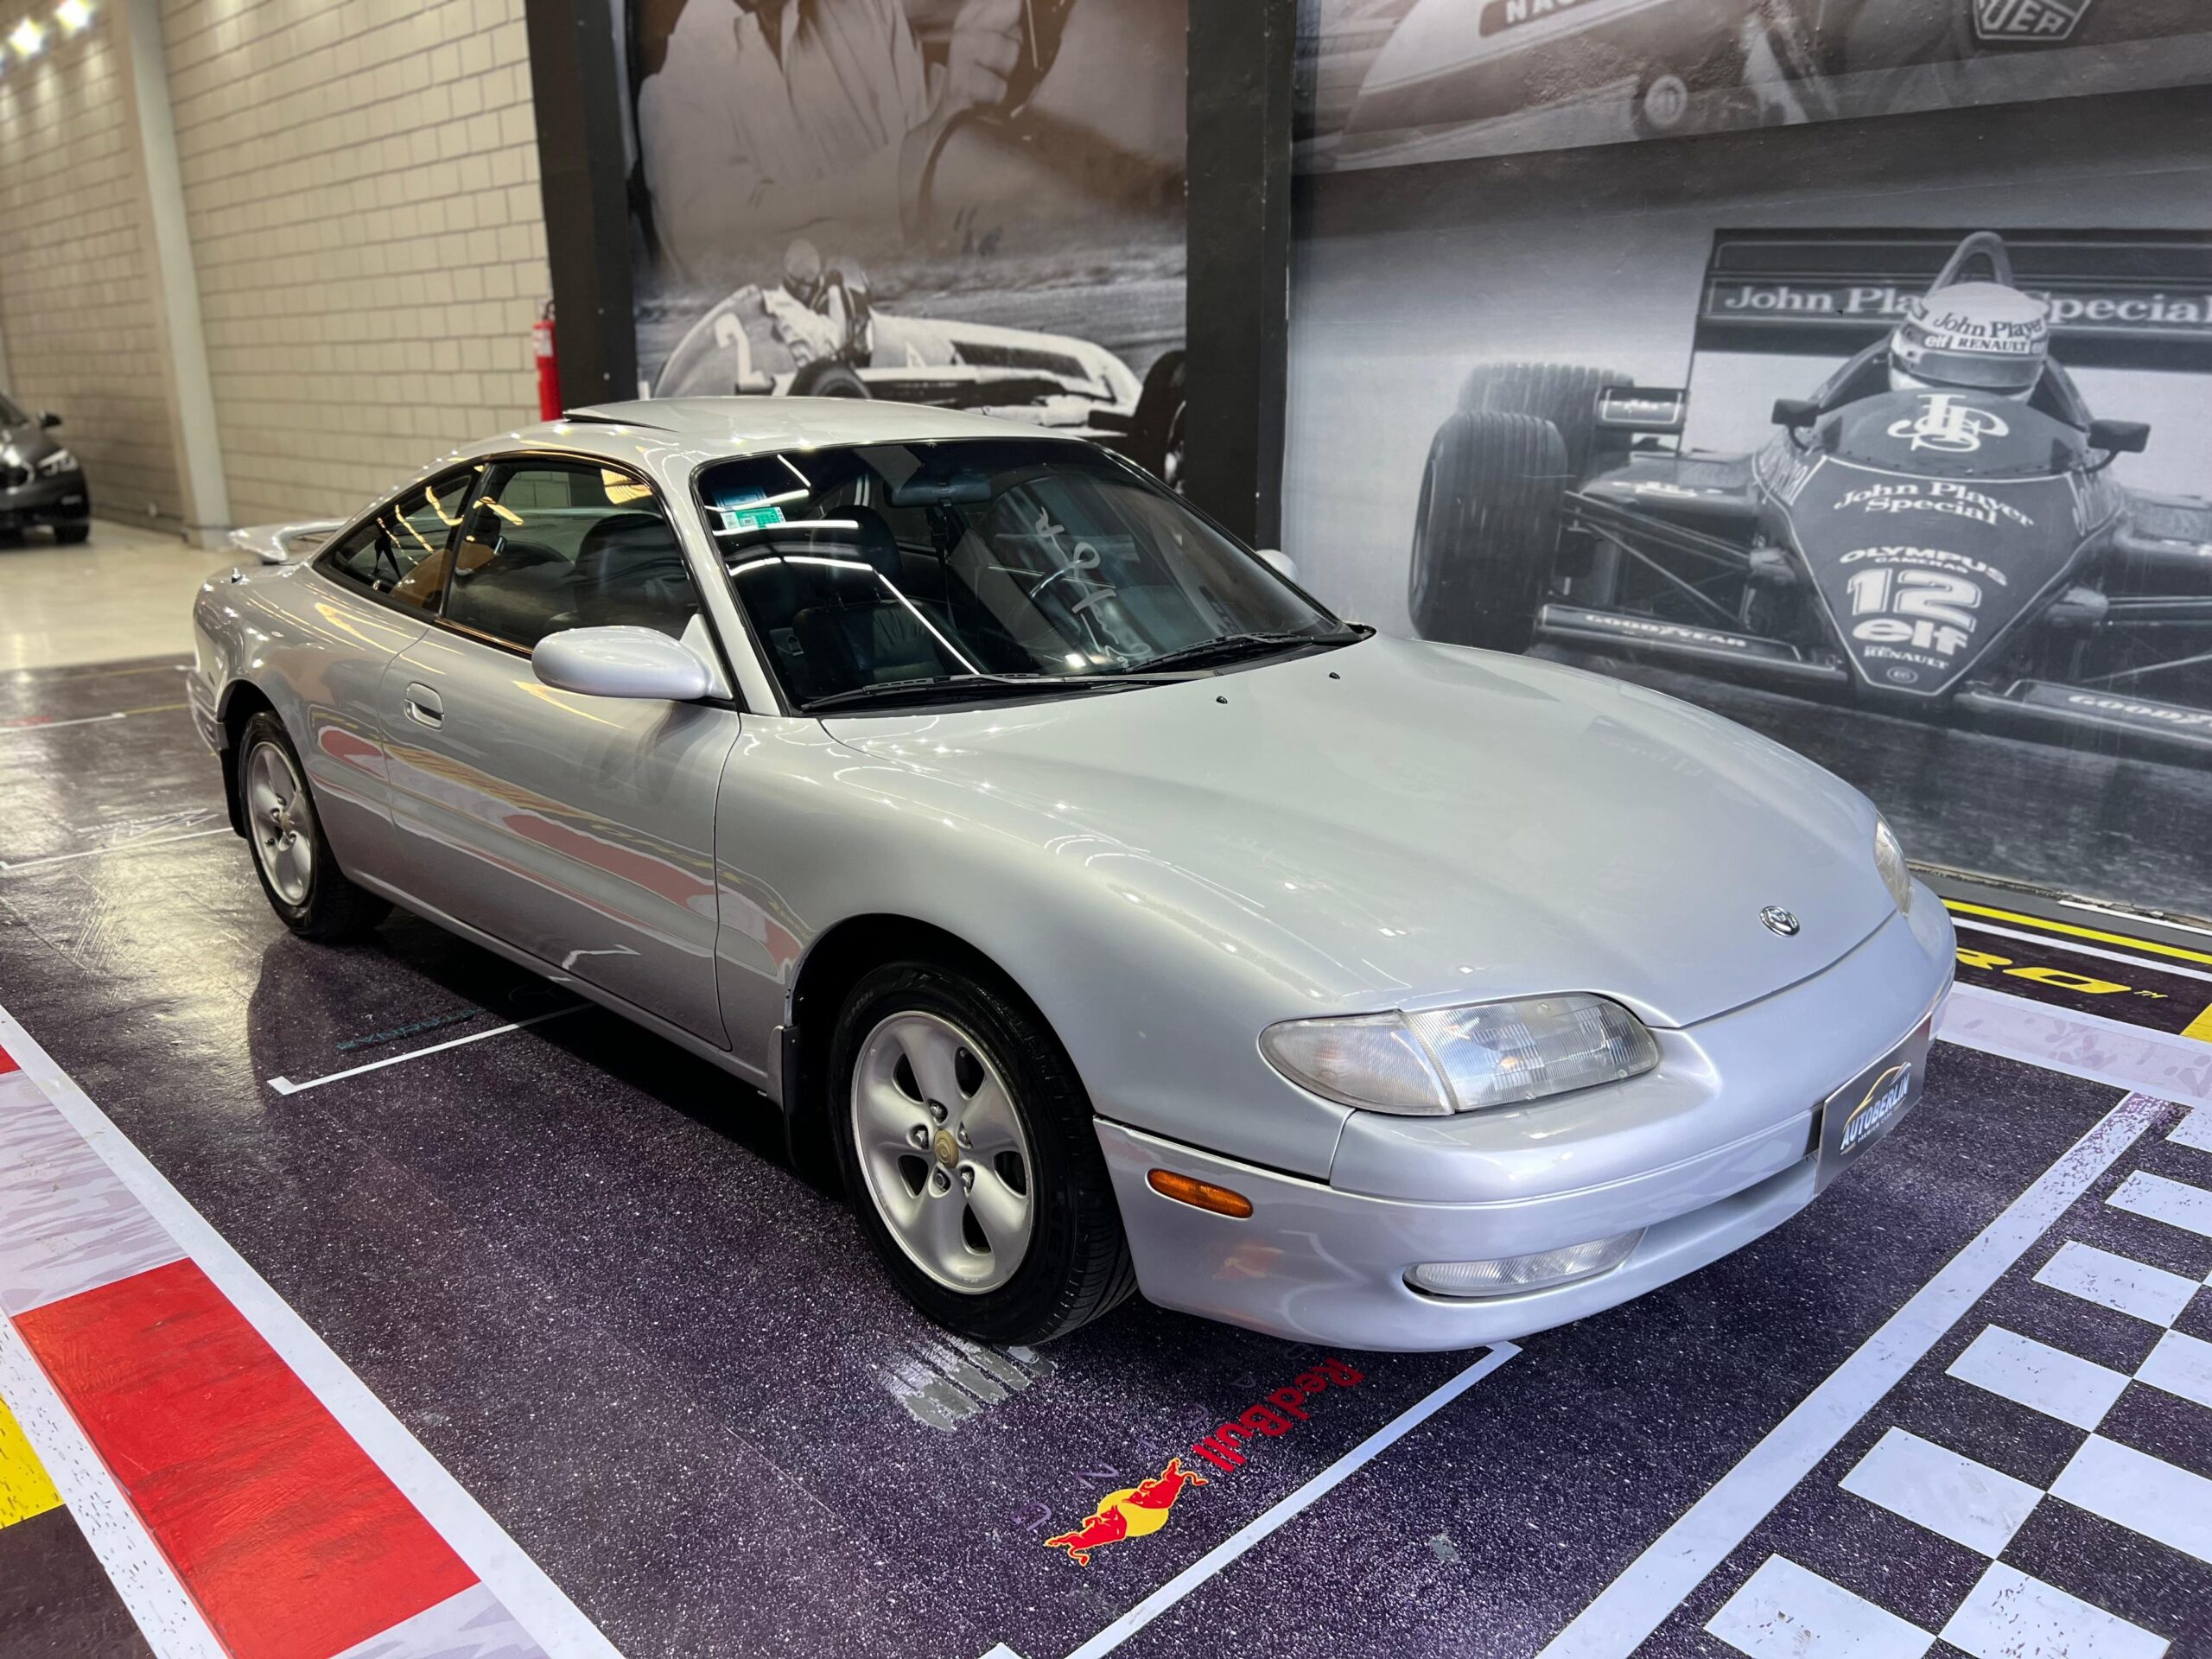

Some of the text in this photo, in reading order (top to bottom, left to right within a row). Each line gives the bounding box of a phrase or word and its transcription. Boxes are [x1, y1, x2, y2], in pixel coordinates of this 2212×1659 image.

[1726, 286, 1834, 313] John
[1842, 287, 1925, 314] Pla
[1932, 312, 2042, 340] John Playe
[1957, 338, 2028, 353] RENAULT
[1834, 480, 2034, 527] John Player
[1866, 496, 1998, 526] Special
[1839, 546, 2007, 587] OLYMPUS
[1874, 556, 1968, 574] CAMERAS
[1847, 568, 1982, 632] 12
[1853, 619, 1968, 656] elf
[1864, 645, 1949, 670] RENAULT
[1840, 1072, 1910, 1151] AUTOBERLIN
